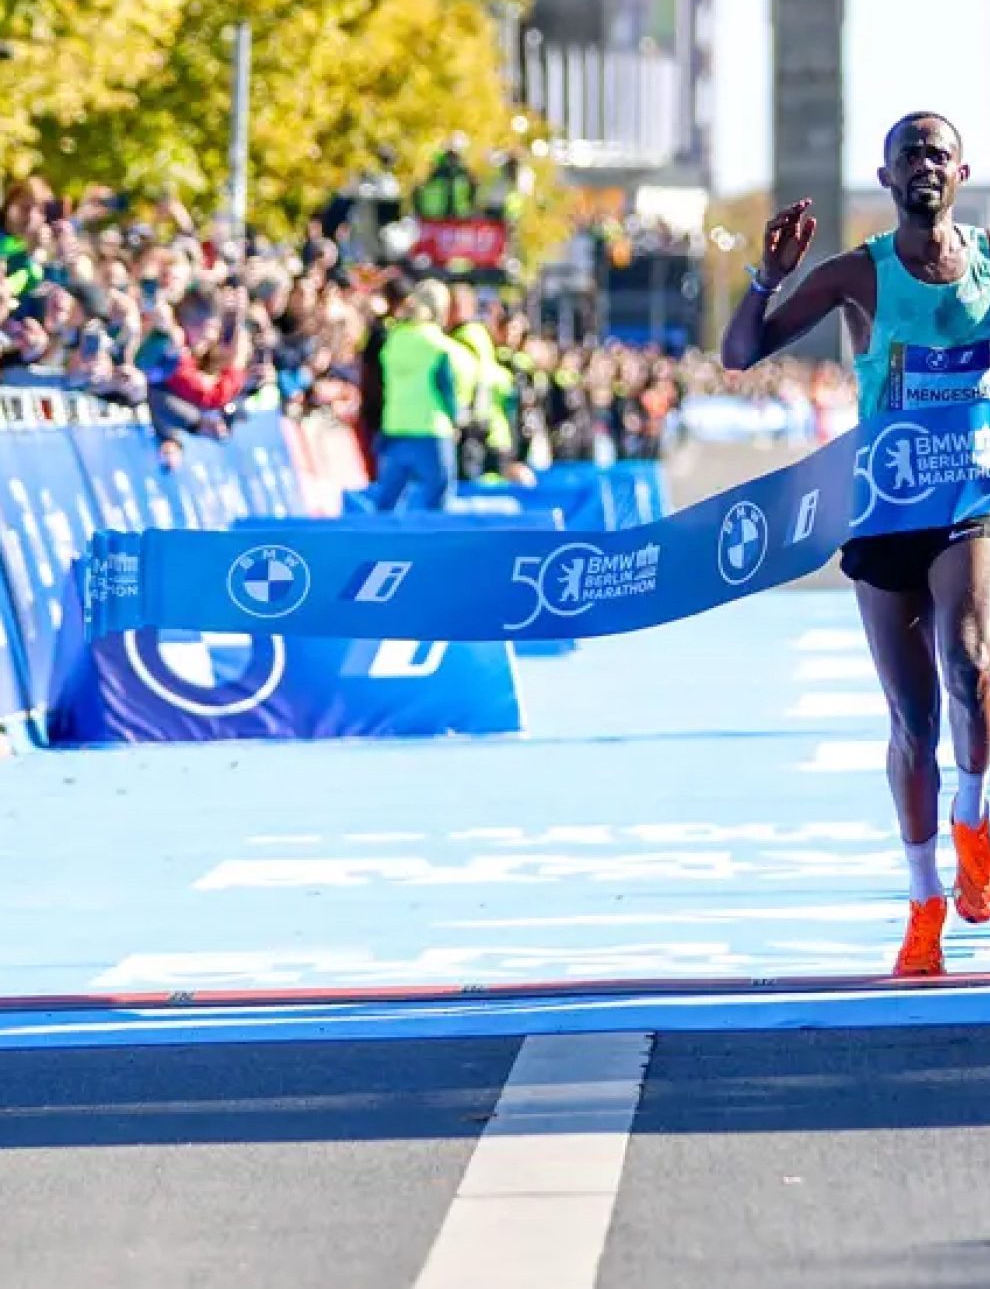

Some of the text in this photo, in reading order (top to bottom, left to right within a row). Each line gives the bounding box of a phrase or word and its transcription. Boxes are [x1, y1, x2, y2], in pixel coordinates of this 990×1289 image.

[915, 431, 975, 456] BMW
[587, 552, 635, 574] BMW
[583, 577, 656, 601] MARATHON
[585, 571, 632, 588] BERLIN
